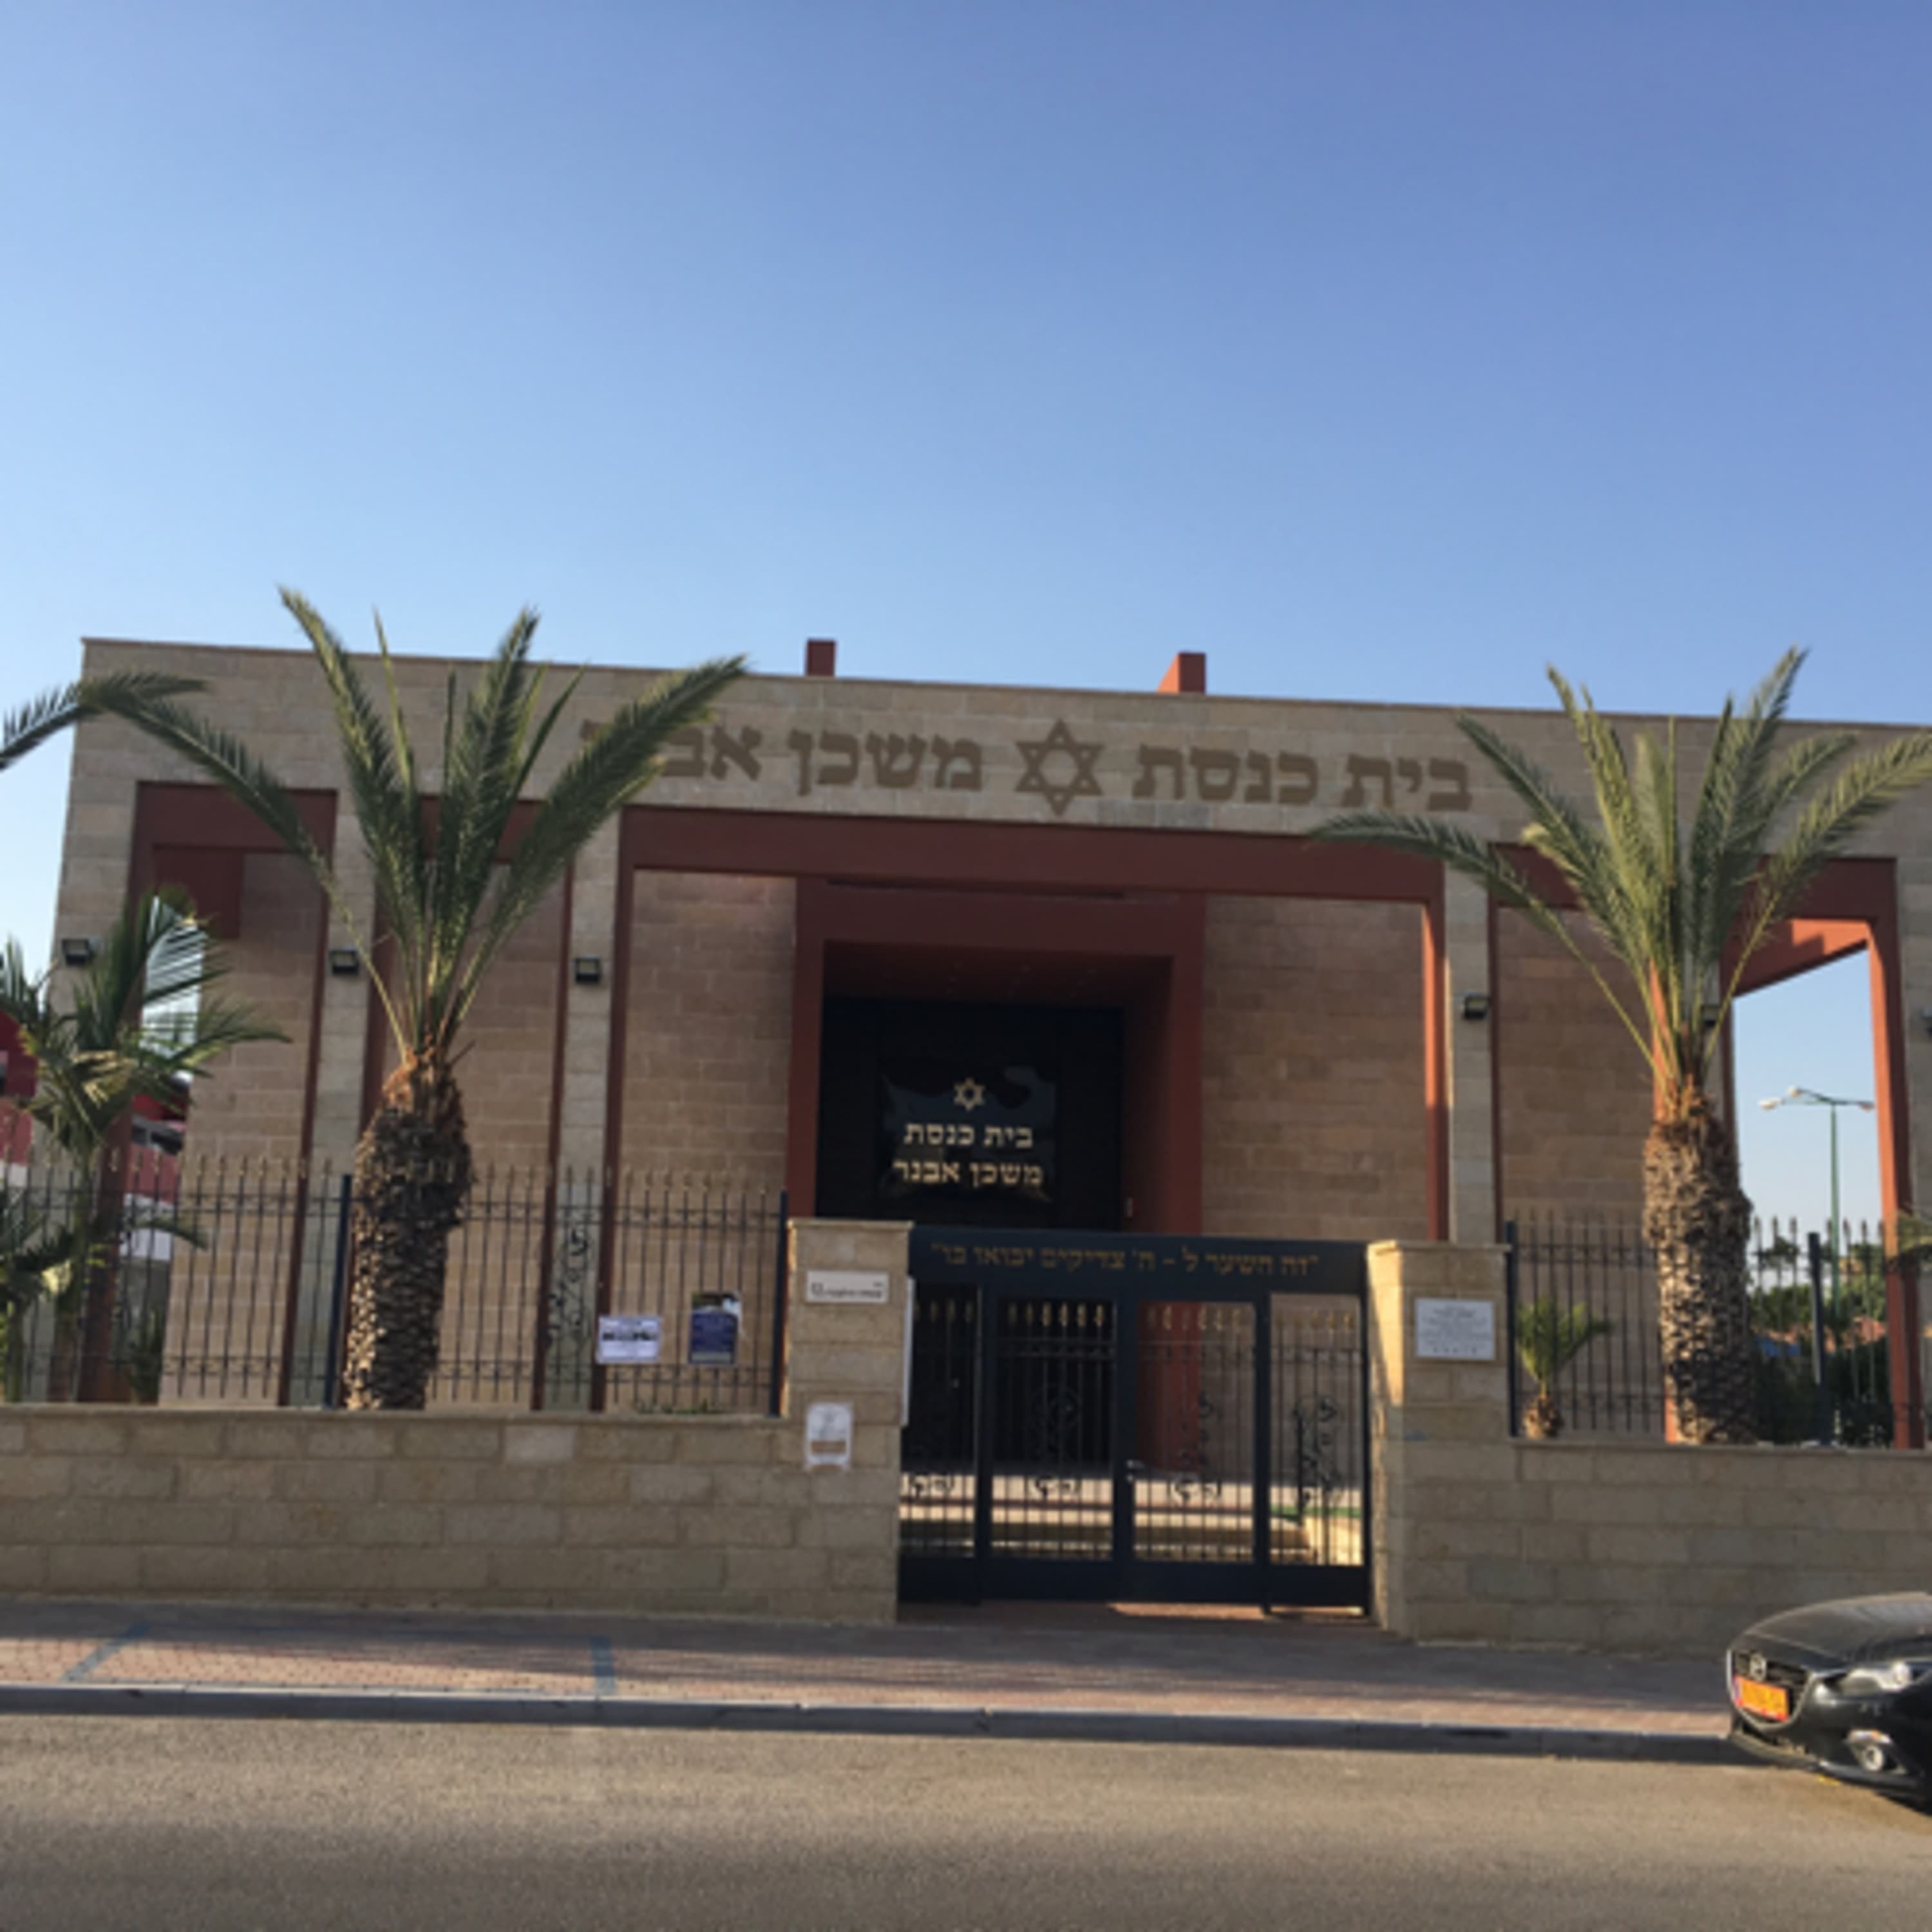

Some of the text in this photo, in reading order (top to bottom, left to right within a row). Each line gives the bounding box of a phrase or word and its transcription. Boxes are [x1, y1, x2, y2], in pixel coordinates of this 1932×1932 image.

[580, 718, 1473, 811] בית כנסת משכן אב
[904, 1123, 1033, 1148] בית כנסת
[893, 1159, 1044, 1188] משכן אבנר
